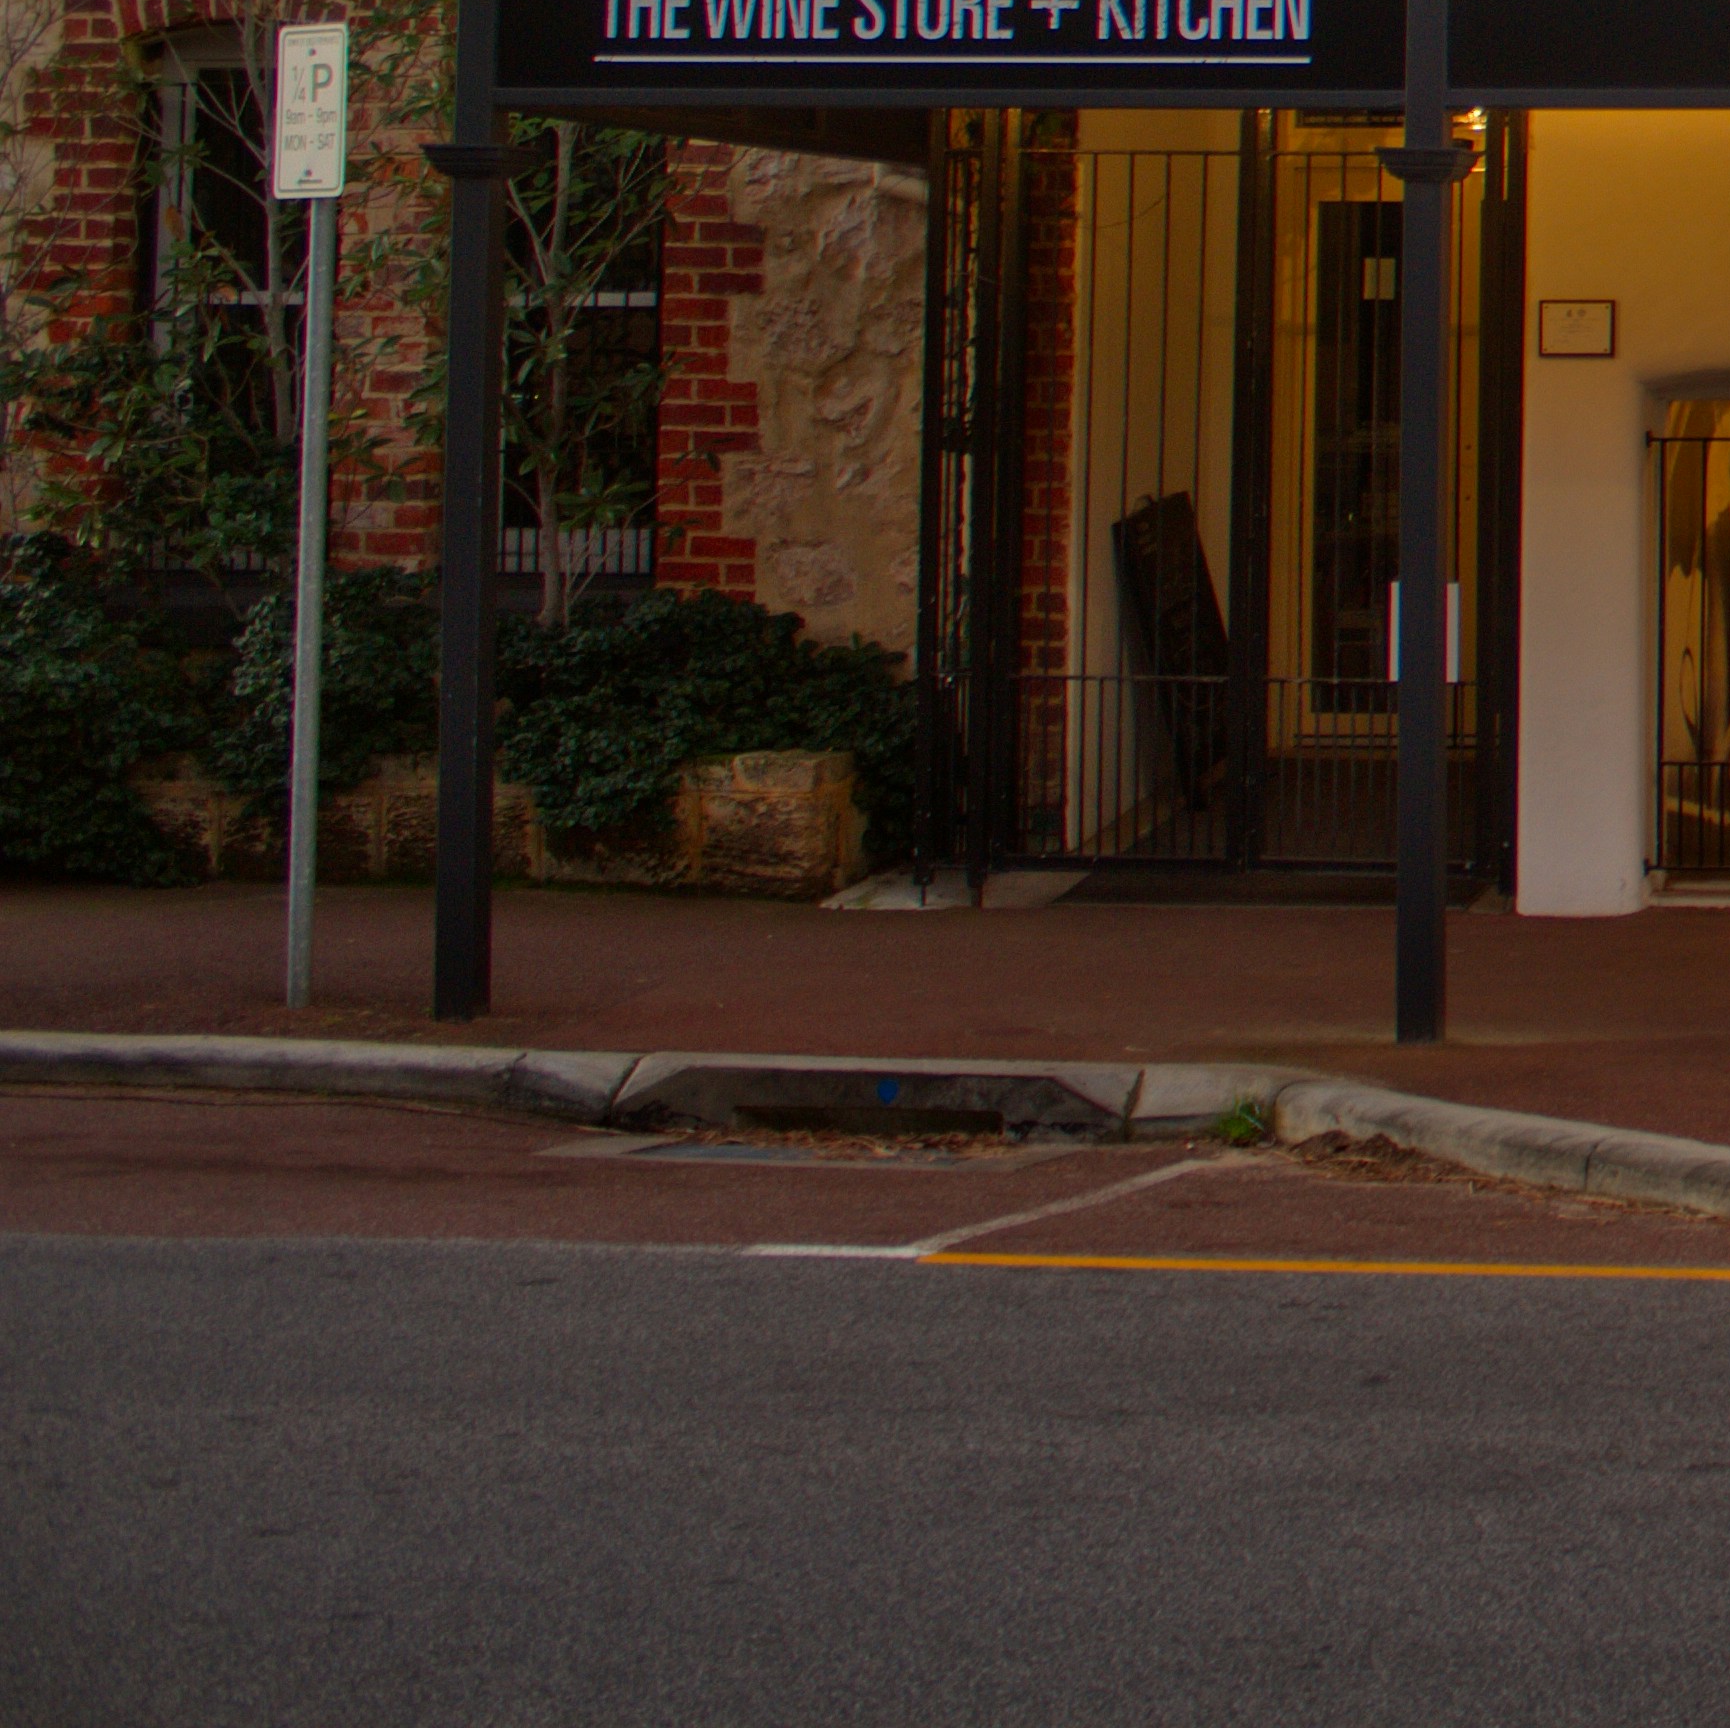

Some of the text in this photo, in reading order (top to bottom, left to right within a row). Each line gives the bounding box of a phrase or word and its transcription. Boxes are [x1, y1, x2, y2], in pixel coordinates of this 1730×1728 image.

[311, 63, 333, 103] P
[284, 134, 307, 151] MON
[317, 133, 336, 150] SAT
